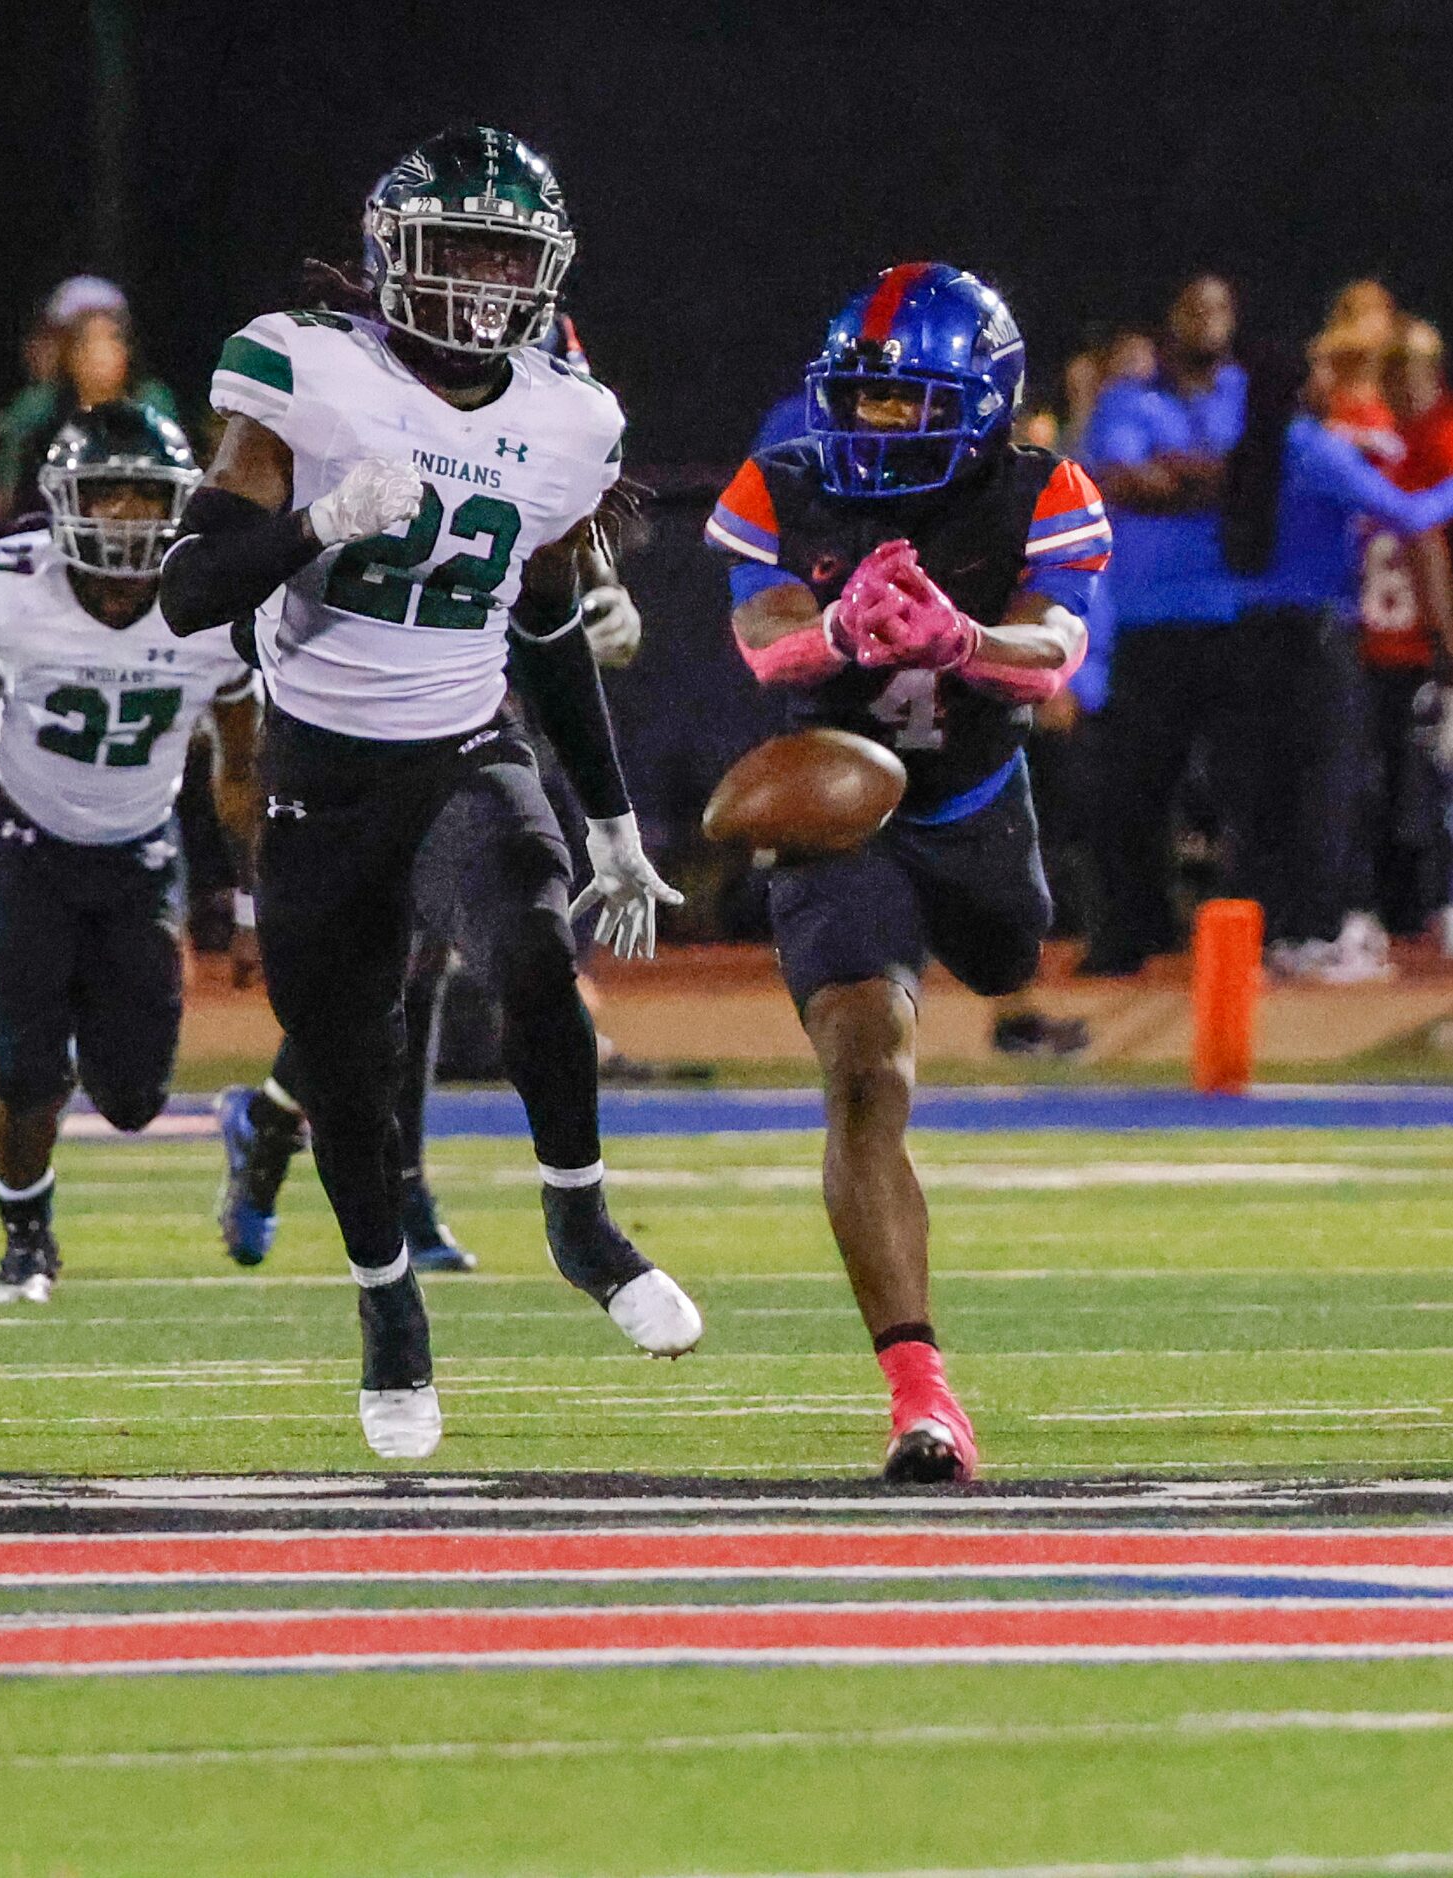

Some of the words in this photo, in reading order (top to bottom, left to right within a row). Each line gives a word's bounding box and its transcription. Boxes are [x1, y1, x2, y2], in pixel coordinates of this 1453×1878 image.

[412, 449, 502, 488] INDIANS
[324, 481, 522, 630] 22
[36, 683, 183, 767] 27
[868, 668, 944, 750] 4
